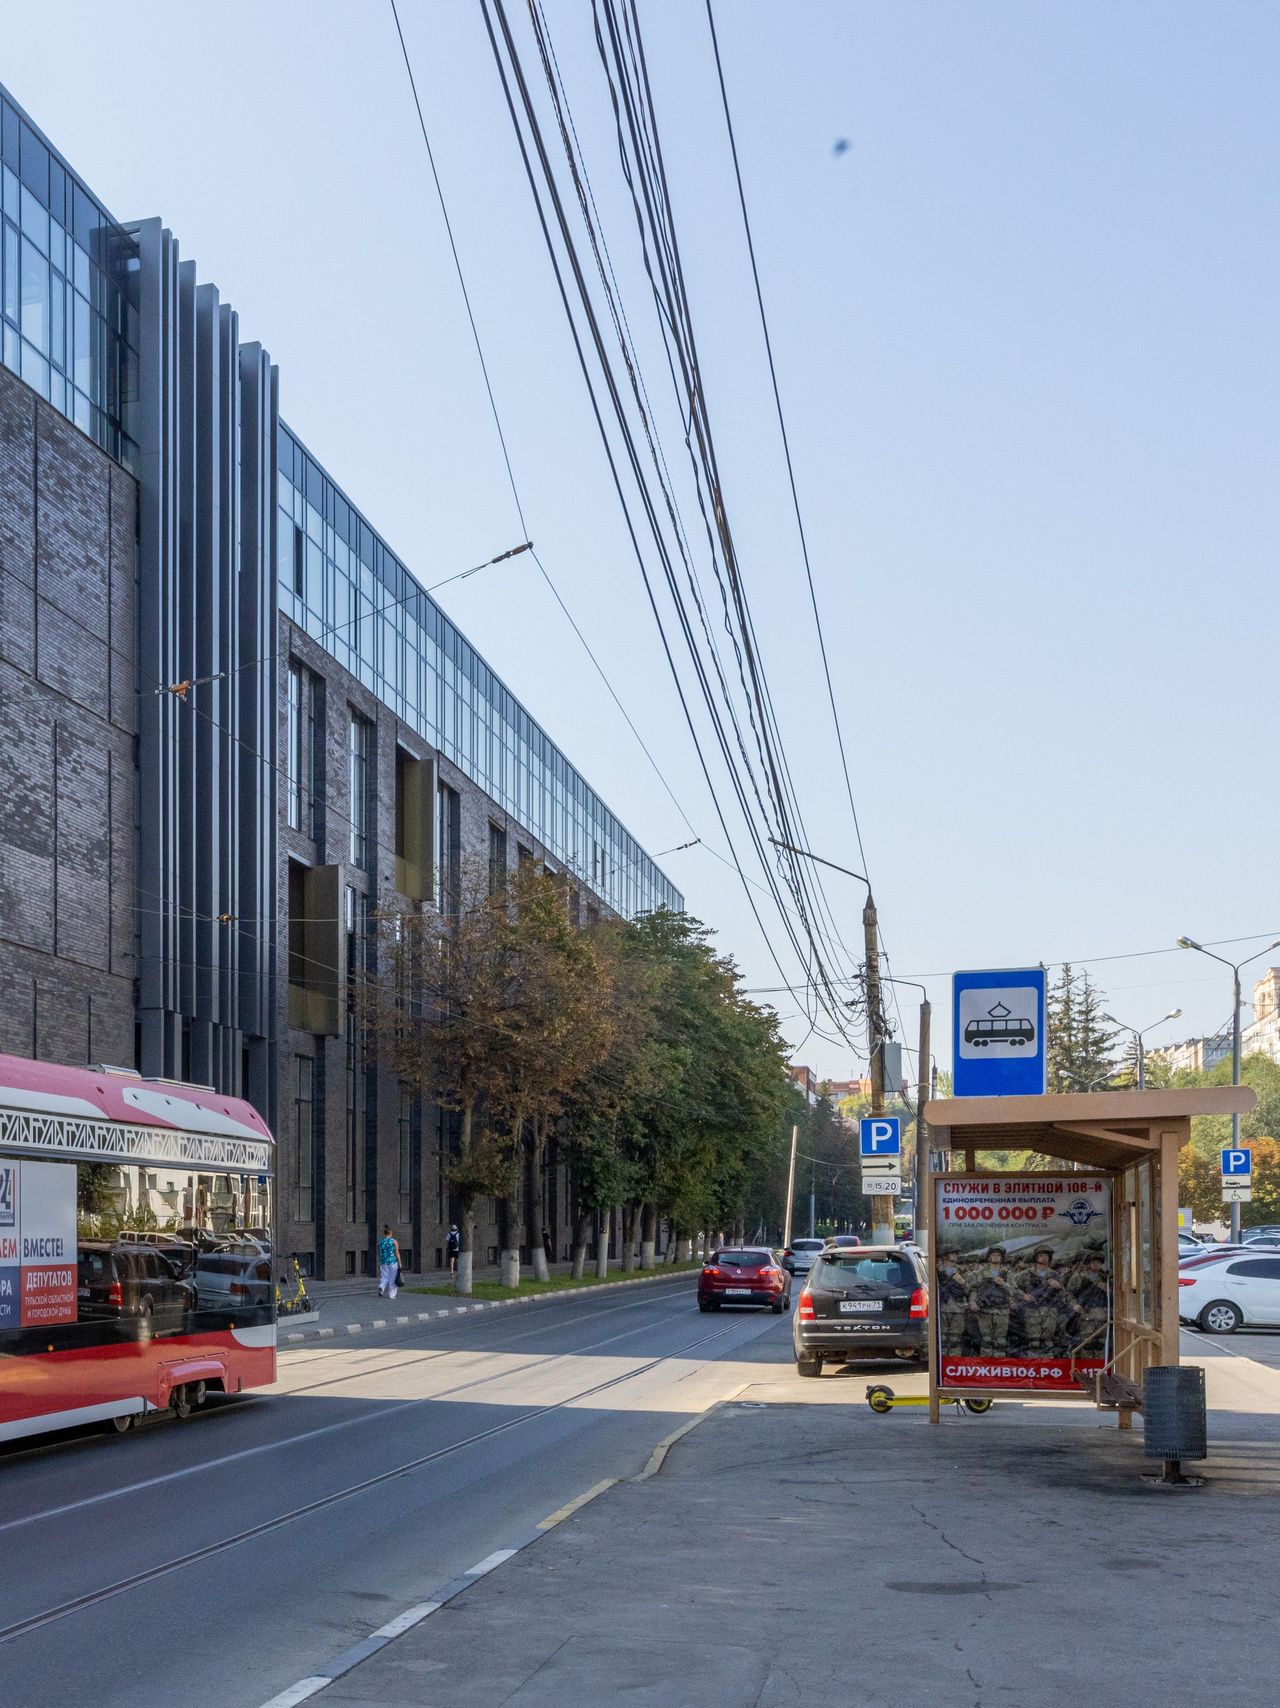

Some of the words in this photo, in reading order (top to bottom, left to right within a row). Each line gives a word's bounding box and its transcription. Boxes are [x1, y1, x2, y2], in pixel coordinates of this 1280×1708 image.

[871, 1122, 893, 1151] P
[1229, 1152, 1246, 1172] P
[885, 1182, 897, 1191] 20
[944, 1182, 989, 1194] СЛУЖИ
[993, 1182, 1001, 1194] В
[1005, 1181, 1063, 1194] ЭЛИТНОЙ
[942, 1206, 950, 1220] 1
[954, 1206, 994, 1221] 000
[998, 1206, 1038, 1221] 000
[23, 1238, 64, 1258] ВМЕСТЕ!
[26, 1270, 73, 1291] ДЕПУТАТОВ
[25, 1294, 48, 1306] ТУЛЬСКОЙ
[946, 1365, 1063, 1379] СЛУЖИВ106.РФ
